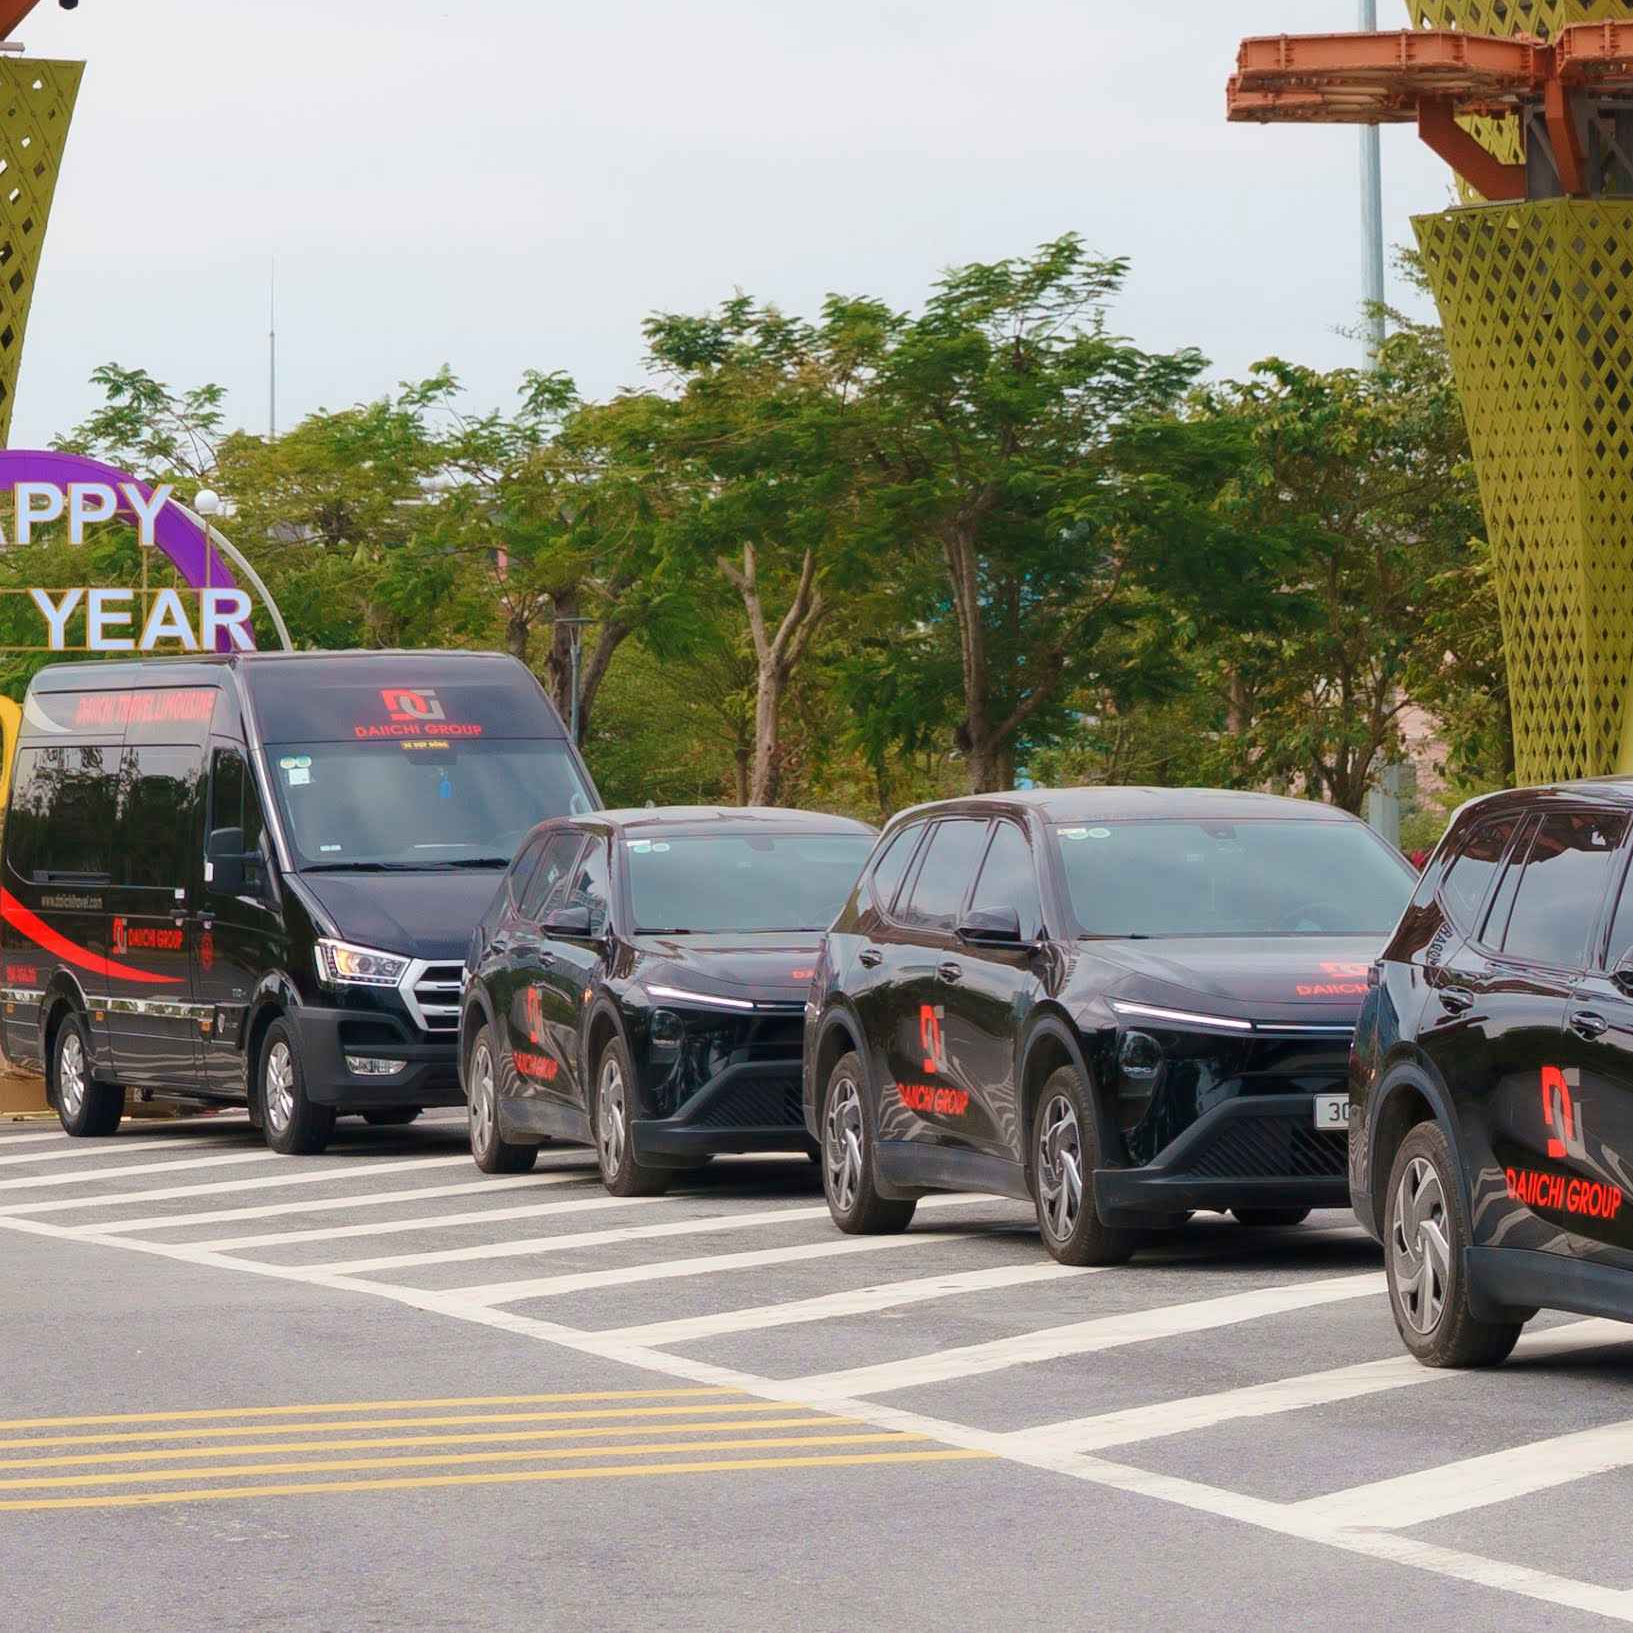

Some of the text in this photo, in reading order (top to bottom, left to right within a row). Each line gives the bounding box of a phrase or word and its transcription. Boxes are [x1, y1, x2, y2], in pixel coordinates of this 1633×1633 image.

[26, 587, 257, 653] YEAR
[354, 723, 482, 738] DAIICHI GROUP
[1296, 984, 1369, 996] DAIICH
[1505, 1167, 1624, 1219] DAIICHI GROUP
